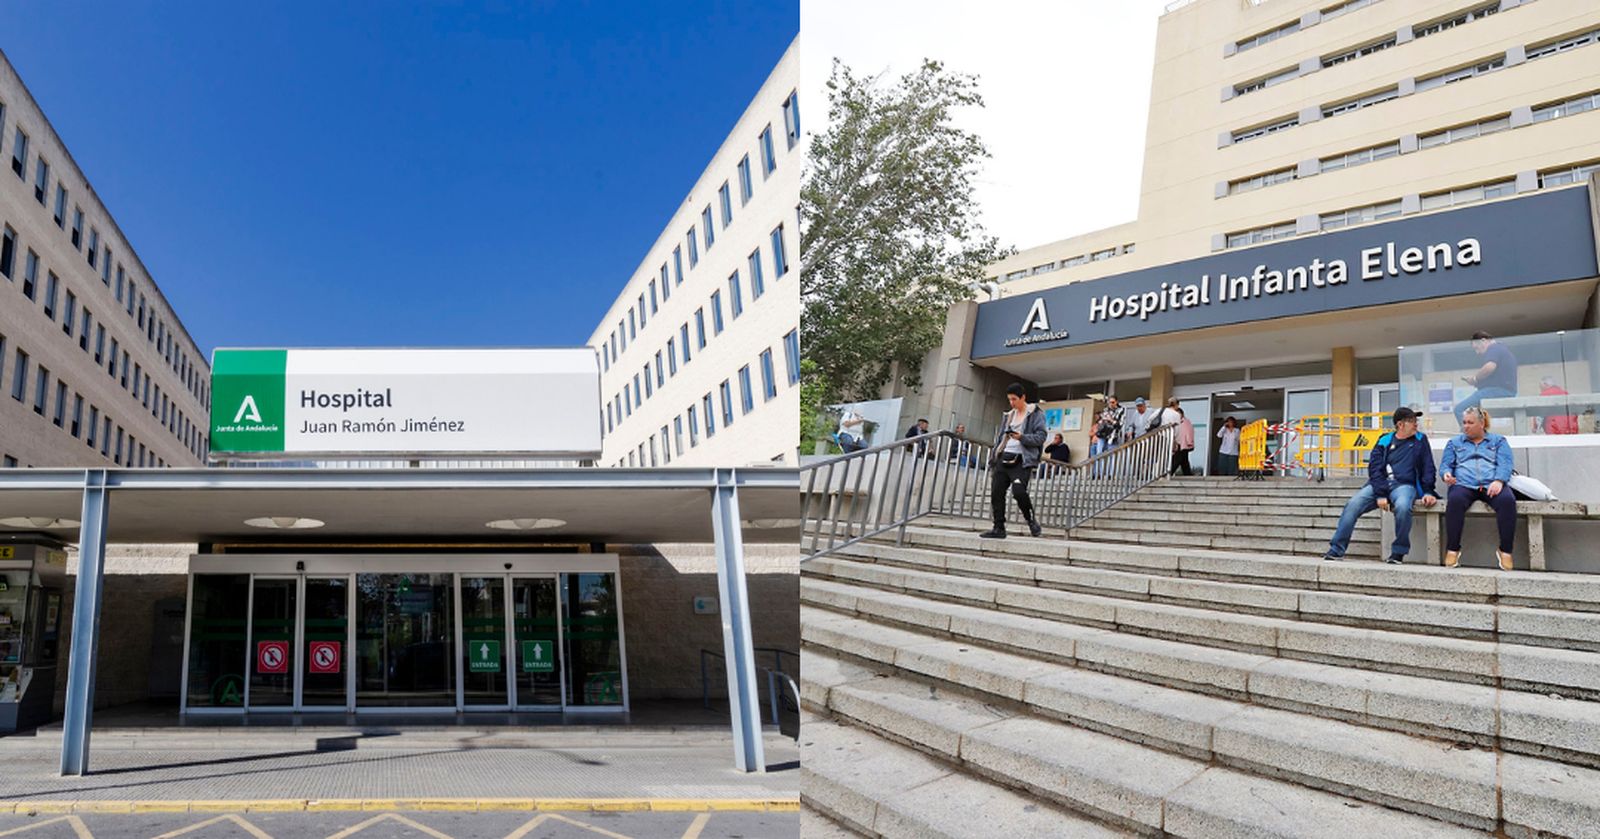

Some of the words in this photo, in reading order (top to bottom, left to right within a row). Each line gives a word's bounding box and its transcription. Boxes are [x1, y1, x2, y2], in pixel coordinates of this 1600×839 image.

[1089, 274, 1211, 322] Hospital
[1219, 258, 1349, 302] Infanta
[1361, 237, 1482, 280] Elena
[301, 388, 392, 412] Hospital
[300, 419, 338, 434] Juan
[342, 417, 396, 433] Ramón
[400, 416, 465, 433] Jiménez
